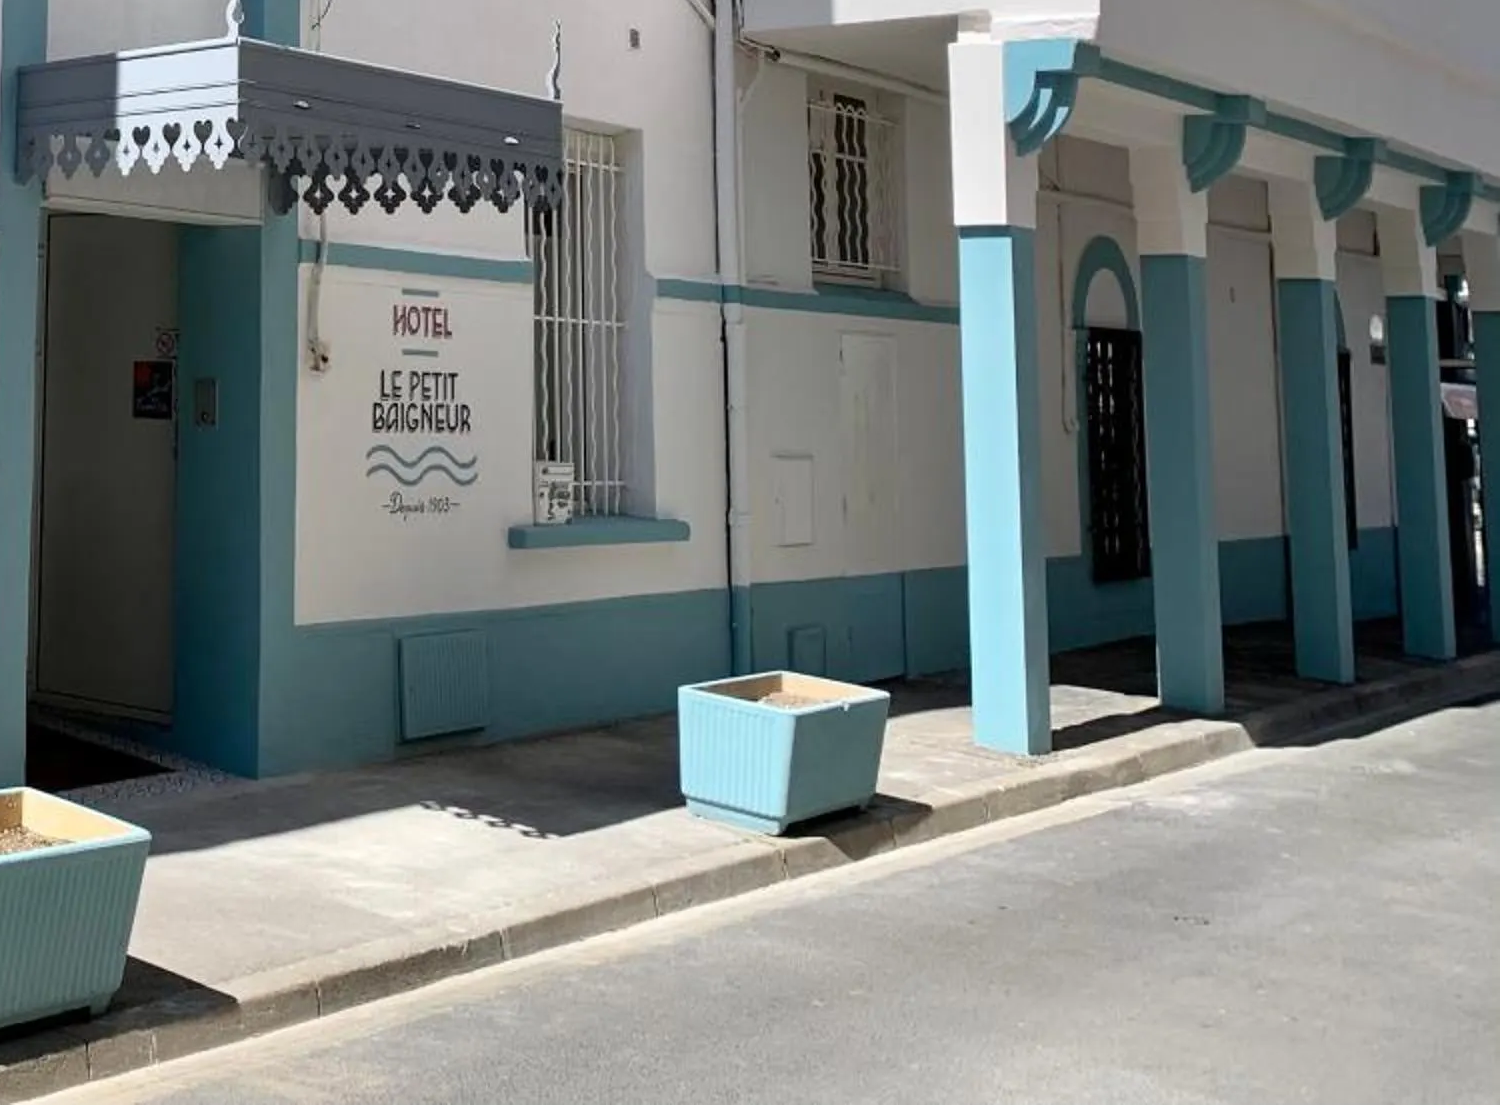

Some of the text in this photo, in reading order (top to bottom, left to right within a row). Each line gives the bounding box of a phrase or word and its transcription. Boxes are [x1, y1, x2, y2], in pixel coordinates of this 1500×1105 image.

[392, 305, 452, 338] HOTEL
[379, 370, 459, 401] LE PETIT
[372, 402, 472, 433] BAIGNEUR
